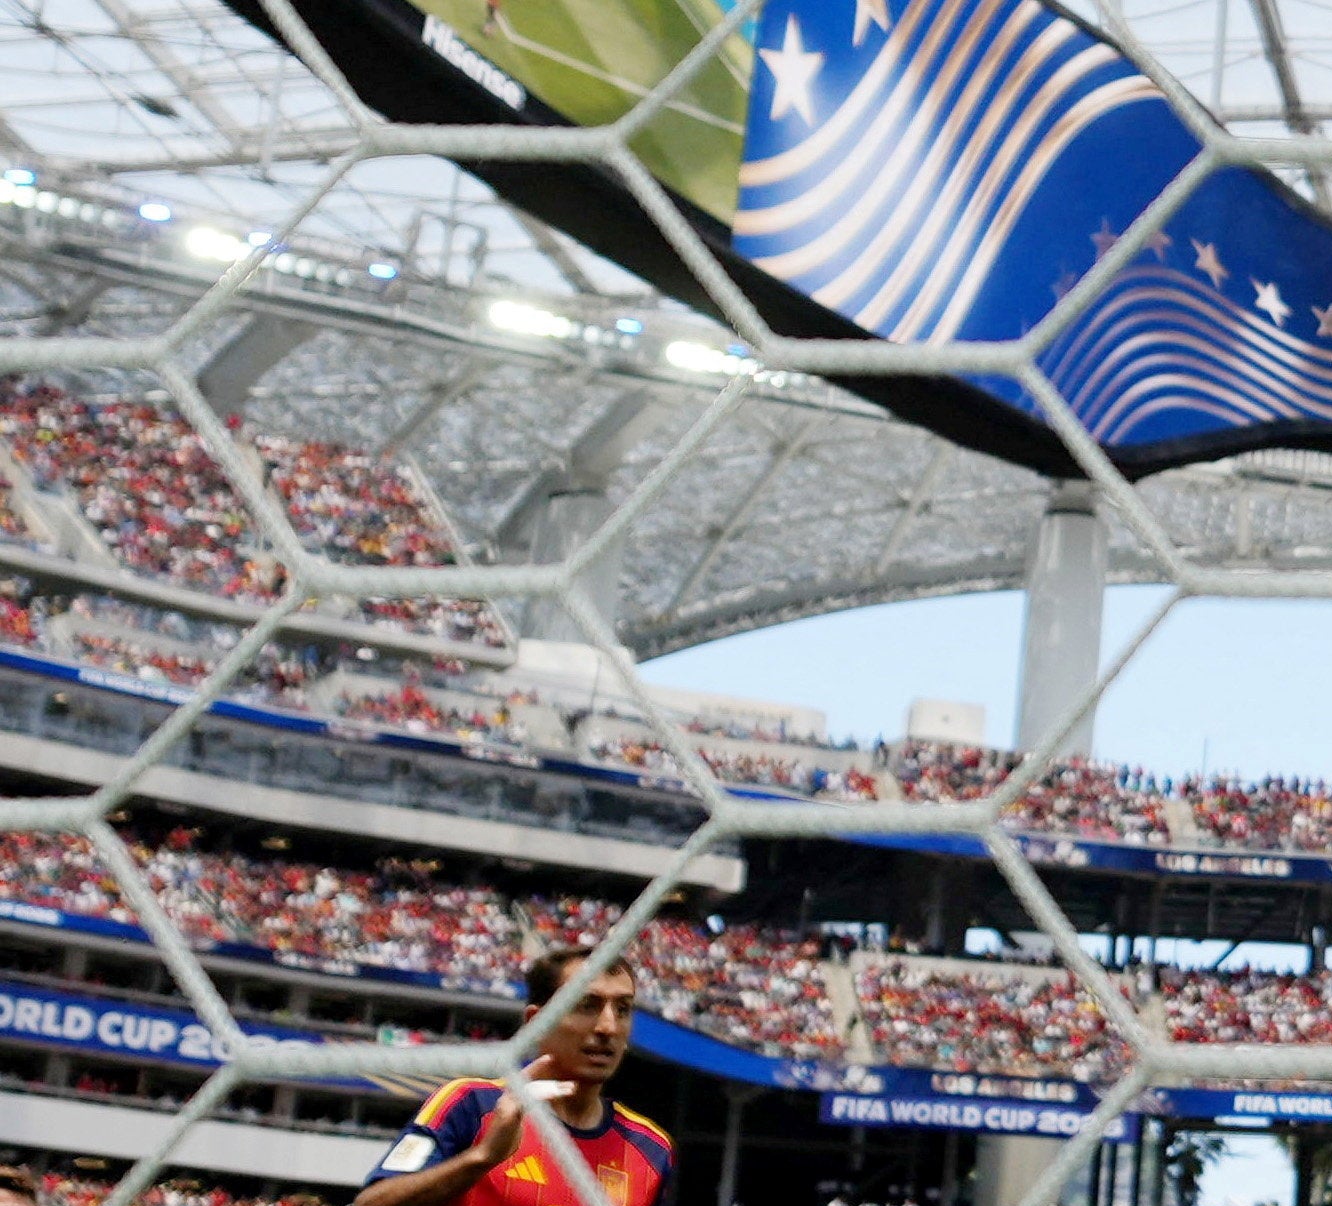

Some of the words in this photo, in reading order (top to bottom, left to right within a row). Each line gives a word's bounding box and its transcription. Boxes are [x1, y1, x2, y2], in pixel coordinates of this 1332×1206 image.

[98, 1011, 179, 1054] CUP
[832, 1096, 890, 1121] FIFA
[890, 1099, 983, 1126] WORLD
[985, 1105, 1036, 1130] CUP
[1233, 1095, 1278, 1113] FIFA
